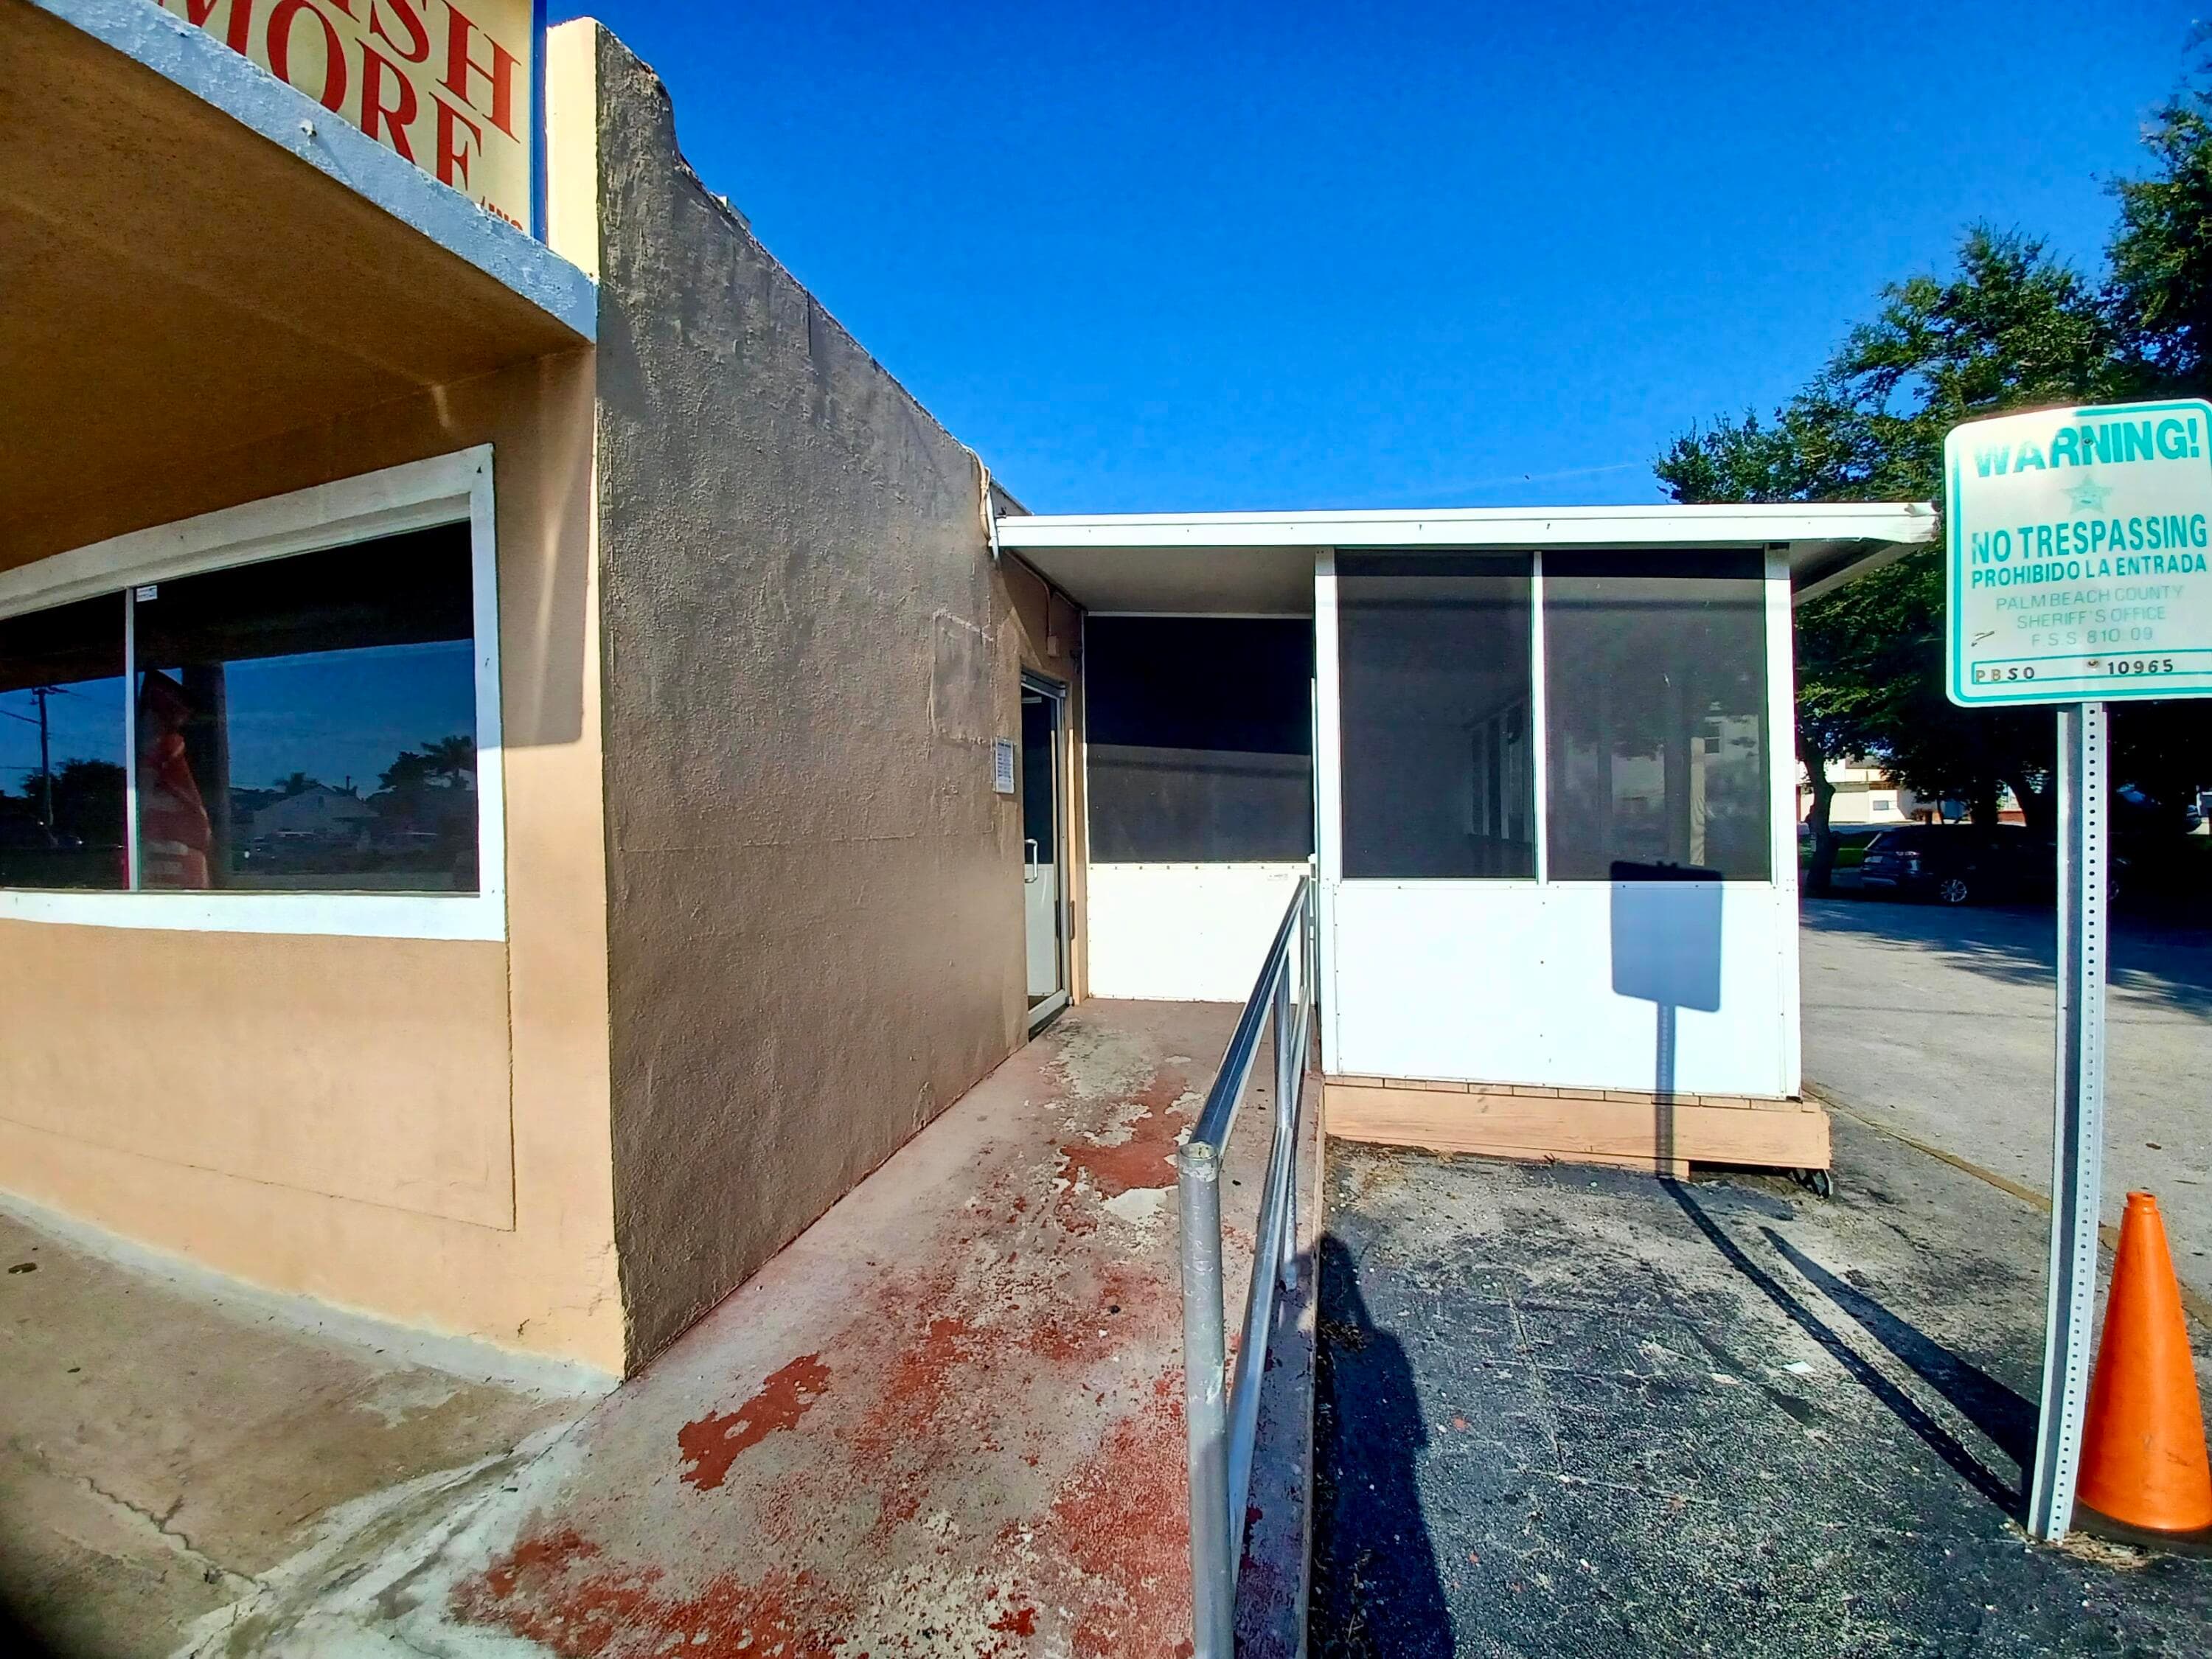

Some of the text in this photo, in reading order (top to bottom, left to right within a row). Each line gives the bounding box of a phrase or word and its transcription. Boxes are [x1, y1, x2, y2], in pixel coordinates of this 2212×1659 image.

[330, 0, 521, 143] SH
[1975, 418, 2200, 477] WARNING!
[1972, 514, 2207, 565] NO TRESPASSING
[1971, 554, 2207, 589] PROHIBIDO LA ENTRADA
[1995, 585, 2184, 611] PALM BEACH COUNTY
[2017, 606, 2166, 629] SHERIFF'S OFFICE
[2107, 659, 2174, 675] 10965
